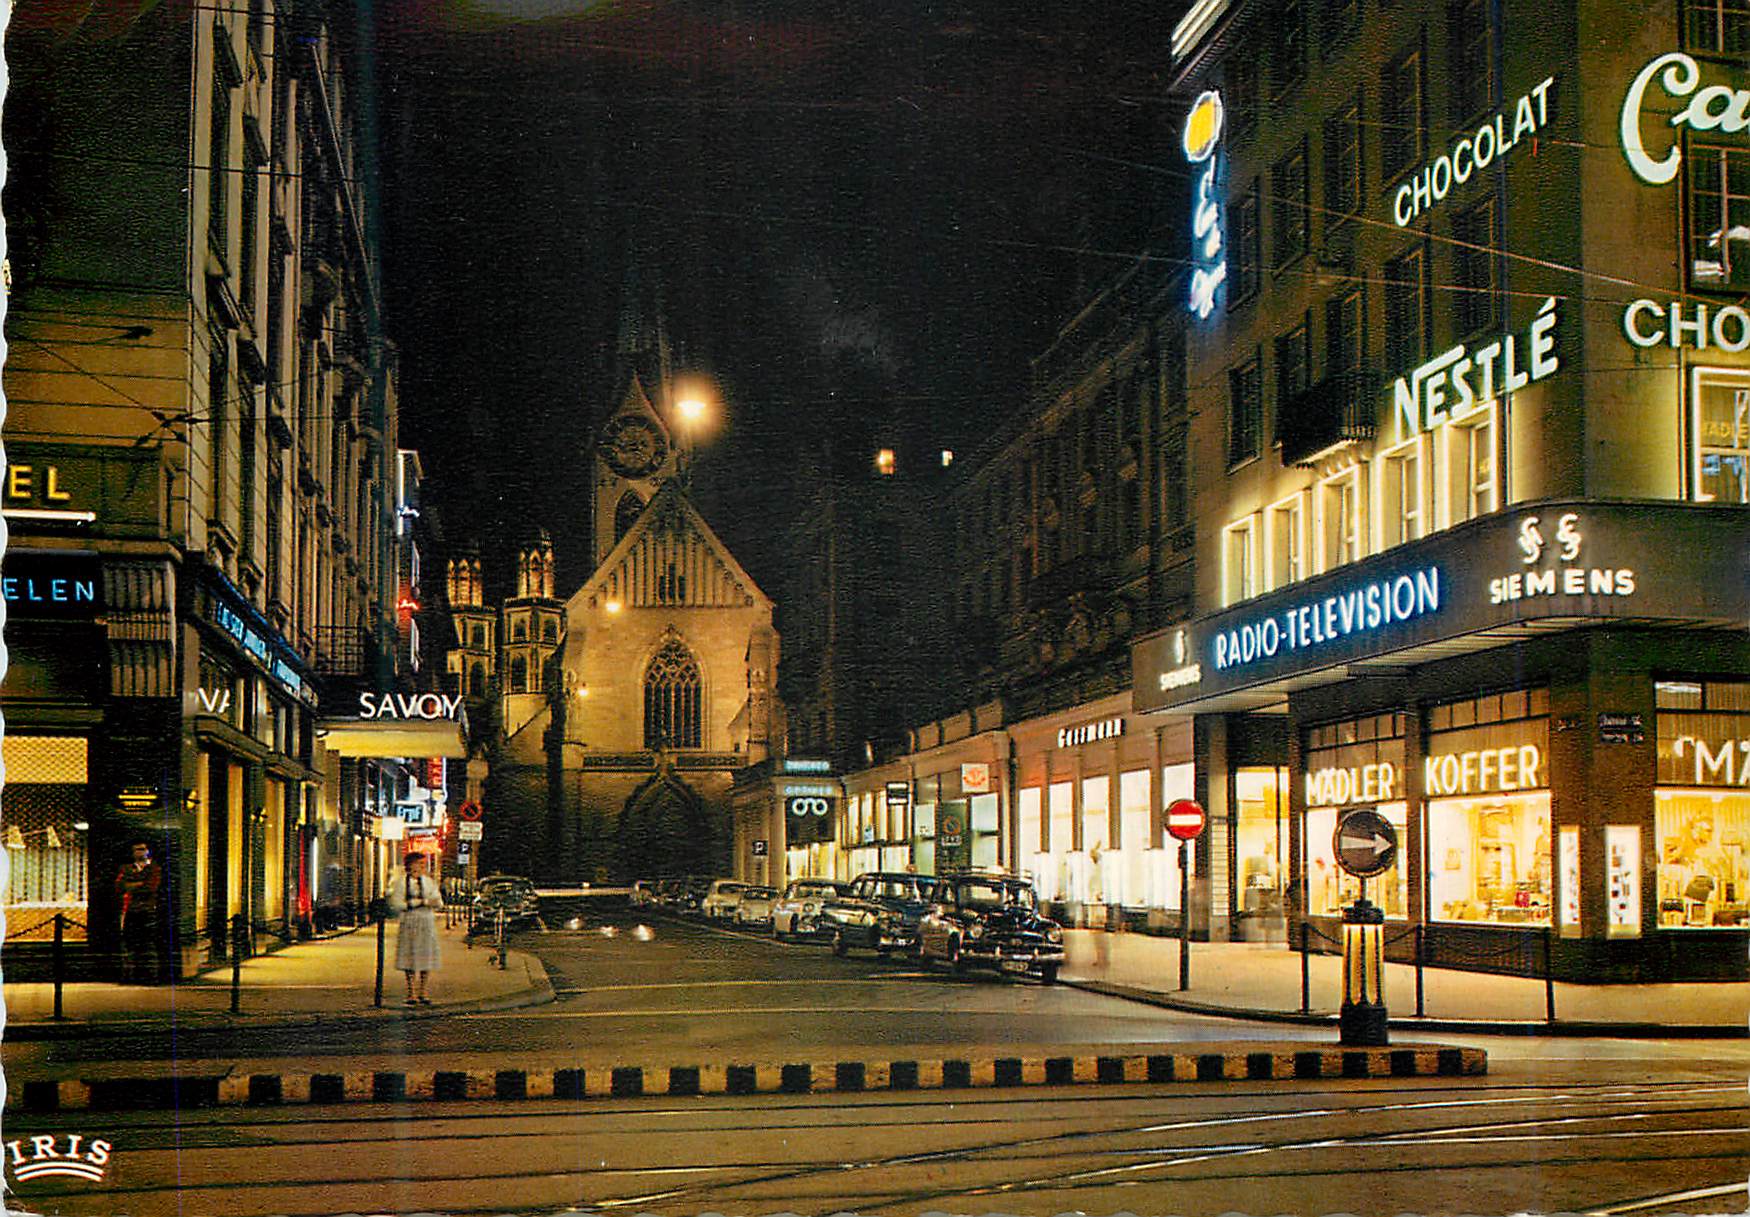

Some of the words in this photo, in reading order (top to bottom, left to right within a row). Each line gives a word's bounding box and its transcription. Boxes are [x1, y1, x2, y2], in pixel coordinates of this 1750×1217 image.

[1394, 77, 1554, 228] CHOCOLAT
[1624, 299, 1750, 352] CHO
[1393, 296, 1559, 444] NESTLÉ
[9, 465, 70, 500] EL
[3, 578, 94, 601] ELEN
[1489, 568, 1635, 604] SIEMENS
[1216, 566, 1441, 669] RADIO-TELEVISION
[359, 692, 463, 719] SAVOY
[1424, 744, 1539, 795] KOFFER
